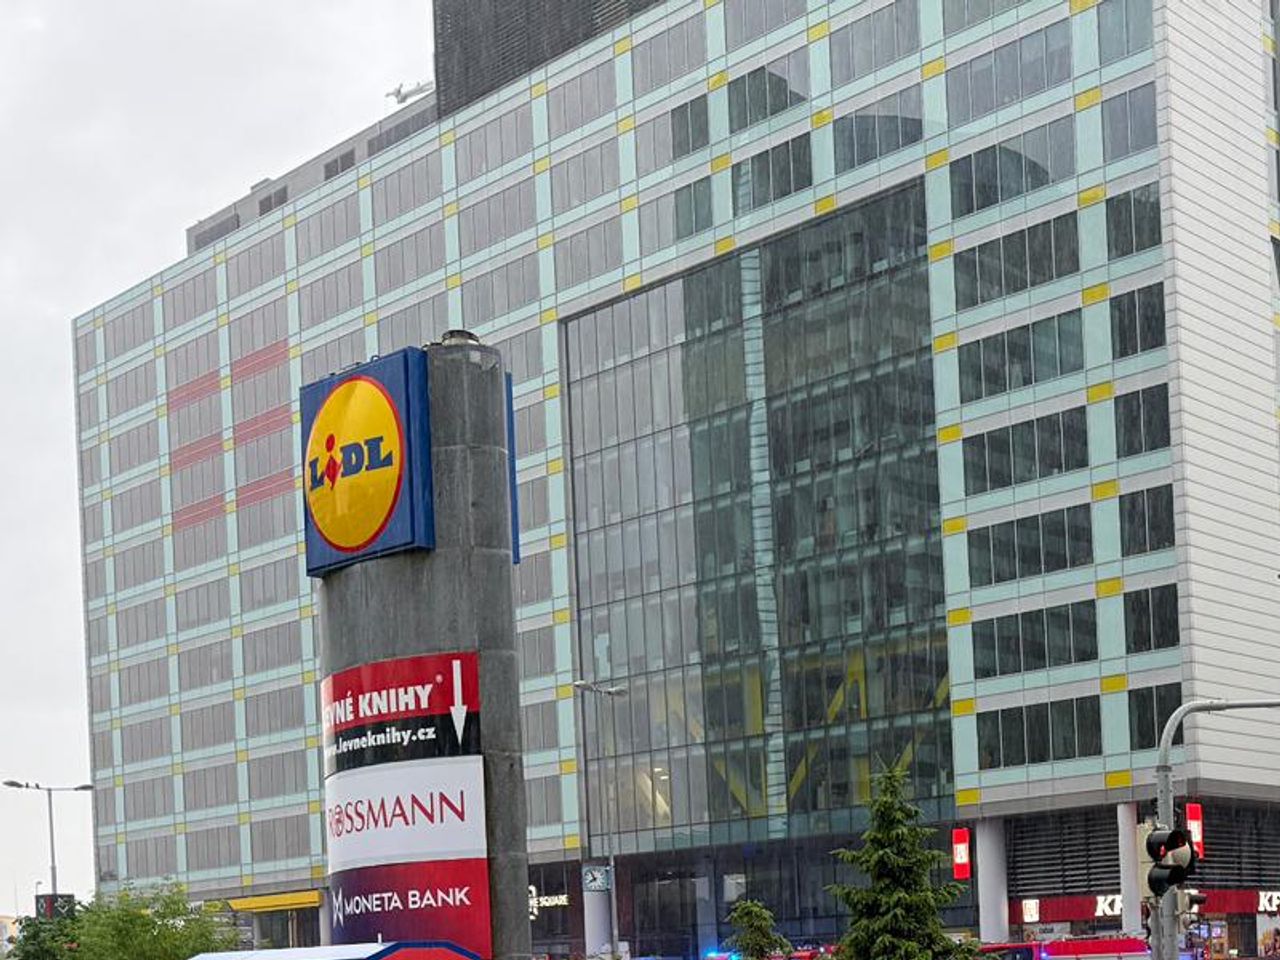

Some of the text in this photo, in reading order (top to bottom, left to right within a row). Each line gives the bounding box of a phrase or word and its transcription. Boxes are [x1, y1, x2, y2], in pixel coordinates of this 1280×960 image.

[358, 683, 433, 718] KNIHY
[344, 886, 471, 915] MONETA BANK
[1094, 894, 1122, 916] KF
